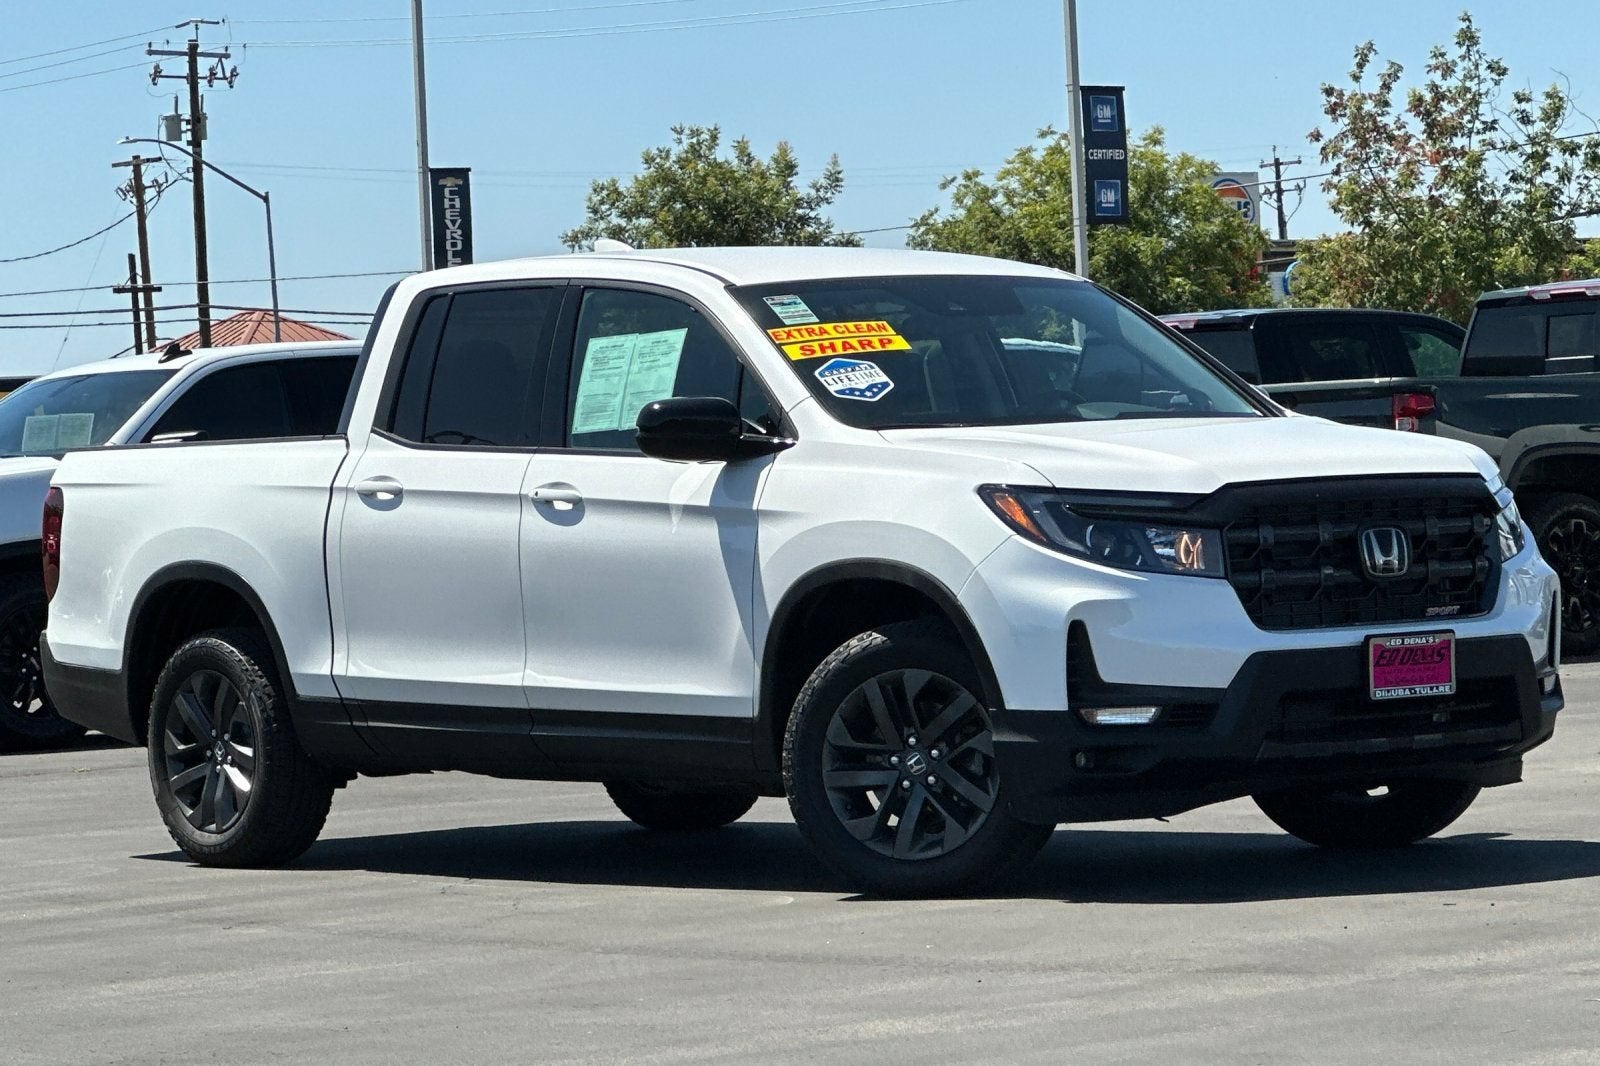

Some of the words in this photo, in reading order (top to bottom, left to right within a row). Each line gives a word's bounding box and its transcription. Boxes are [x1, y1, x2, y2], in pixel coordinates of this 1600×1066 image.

[1097, 104, 1111, 118] GM
[1088, 148, 1125, 160] CERTIFIED
[1101, 188, 1115, 202] GM
[443, 187, 464, 267] CHEVROLE
[771, 326, 829, 342] EXTRA
[834, 322, 889, 336] CLEAN
[799, 338, 894, 356] SHARP
[823, 369, 884, 386] LIFETIME
[1425, 605, 1460, 616] SPORT
[1390, 638, 1402, 646] ED
[1403, 636, 1434, 645] DENA'S
